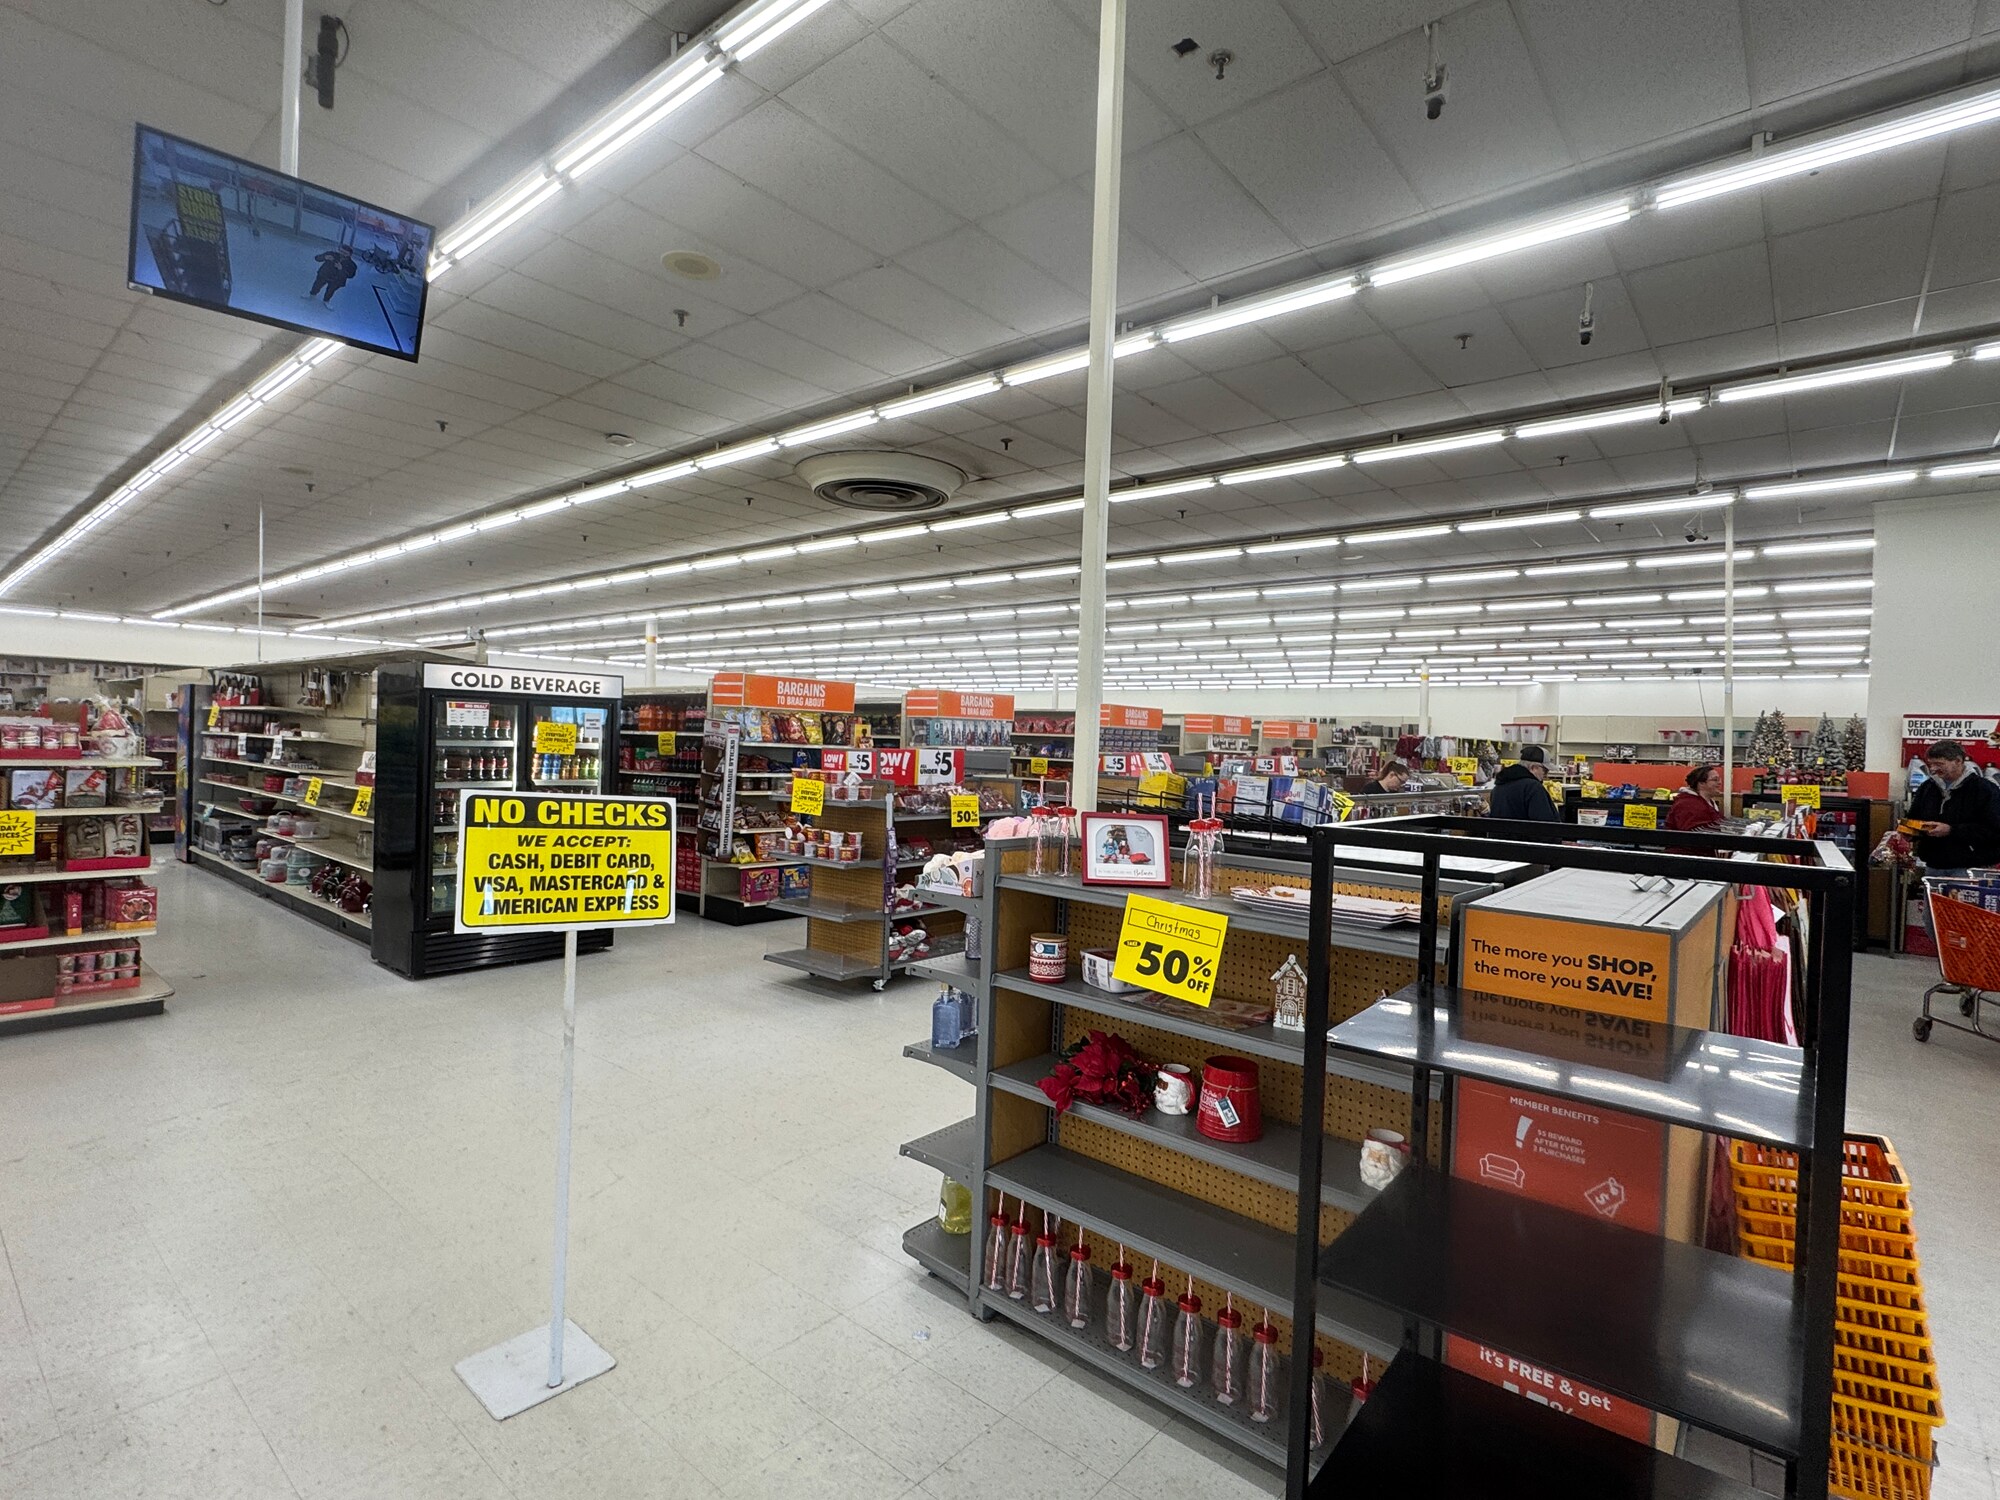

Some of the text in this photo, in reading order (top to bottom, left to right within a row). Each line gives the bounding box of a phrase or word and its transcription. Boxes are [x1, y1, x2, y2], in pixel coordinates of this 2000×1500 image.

[451, 671, 601, 695] COLD BEVERAGE
[777, 681, 826, 697] BARGAINS
[777, 695, 825, 707] TO BRAG ABOUT
[960, 695, 994, 708] BARGAINS
[1125, 708, 1149, 719] BARGAINS
[1908, 720, 1973, 729] DEEP CLEAN IT
[1908, 729, 1954, 737] YOURSELF
[1956, 729, 1962, 737] &
[728, 740, 736, 767] STICKS
[856, 754, 871, 771] $5
[1153, 754, 1167, 771] $5
[935, 751, 953, 776] $5
[1112, 758, 1125, 771] $5
[1263, 760, 1274, 770] $5
[474, 797, 667, 827] NO CHECKS
[517, 834, 632, 848] WE ACCEPT:
[488, 853, 655, 872] CASH, DEBIT CARD,
[474, 874, 665, 896] VISA, MASTERCARD &
[478, 894, 659, 916] AMERICAN EXPRESS
[1146, 915, 1201, 940] Christmas
[1135, 941, 1213, 985] 50%
[1471, 938, 1657, 982] The more you SHOP,
[1187, 978, 1210, 994] OFF
[1474, 960, 1653, 1001] the more you SAVE!
[1509, 1096, 1600, 1124] MEMBER BENEFITS
[1534, 1137, 1586, 1155] AFTER EVERY
[1547, 1131, 1583, 1146] REWARD
[1538, 1146, 1586, 1165] PURCHASES
[1508, 1358, 1555, 1389] FREE
[1559, 1379, 1574, 1398] &
[1578, 1391, 1612, 1412] get
